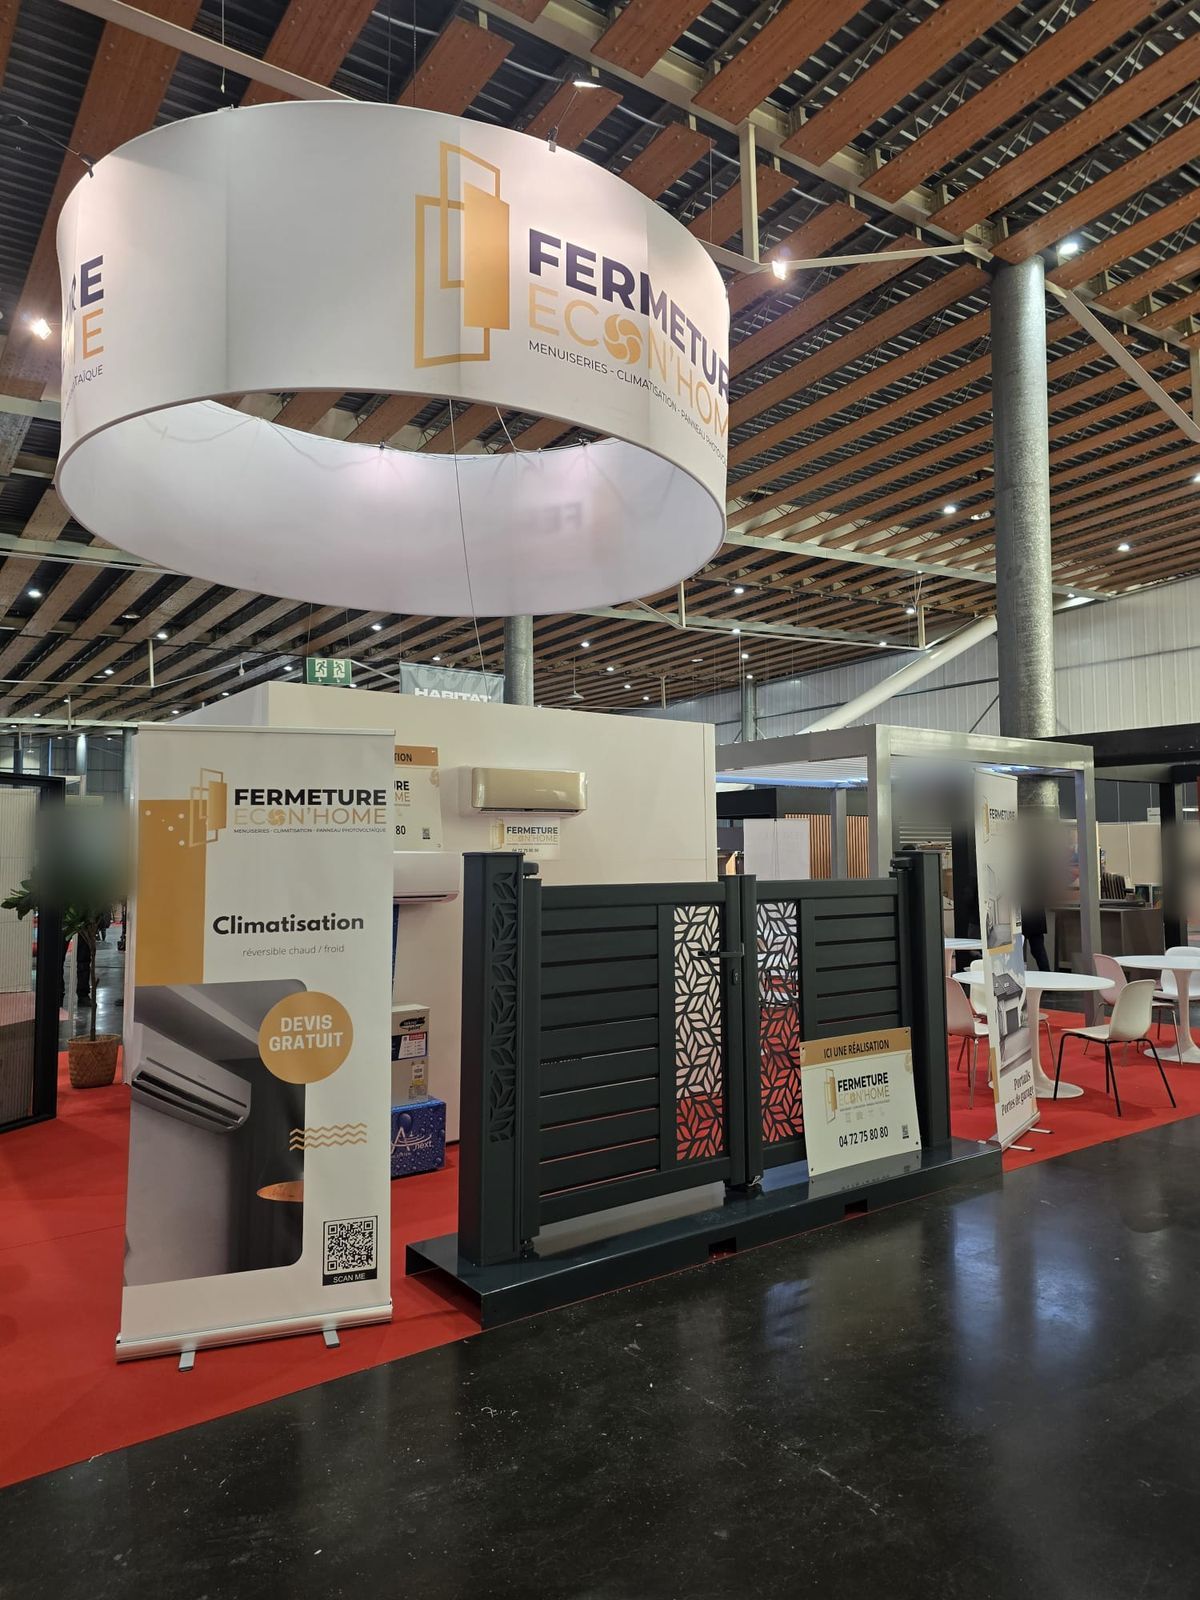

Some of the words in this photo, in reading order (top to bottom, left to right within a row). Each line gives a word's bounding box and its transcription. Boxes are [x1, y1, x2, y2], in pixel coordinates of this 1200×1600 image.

[529, 340, 608, 374] MENUISERIES
[616, 369, 677, 412] CLIMATISATION
[394, 780, 410, 791] RE
[234, 788, 387, 806] FERMETURE
[395, 825, 406, 835] 80
[506, 826, 559, 835] FERMETURE
[212, 912, 364, 935] Climatisation
[242, 946, 287, 957] réversible
[288, 945, 316, 955] chaud
[324, 944, 345, 954] froid
[280, 1014, 333, 1033] DEVIS
[269, 1032, 344, 1052] GRATUIT
[823, 1048, 833, 1059] ICI
[834, 1045, 847, 1057] UNE
[848, 1039, 890, 1056] RÉALISATION
[837, 1071, 889, 1092] FERMETURE
[838, 1135, 848, 1147] 04
[849, 1132, 858, 1145] 72
[859, 1130, 868, 1143] 75
[869, 1128, 879, 1140] 80
[879, 1126, 889, 1138] 80
[333, 1275, 354, 1284] SCAN
